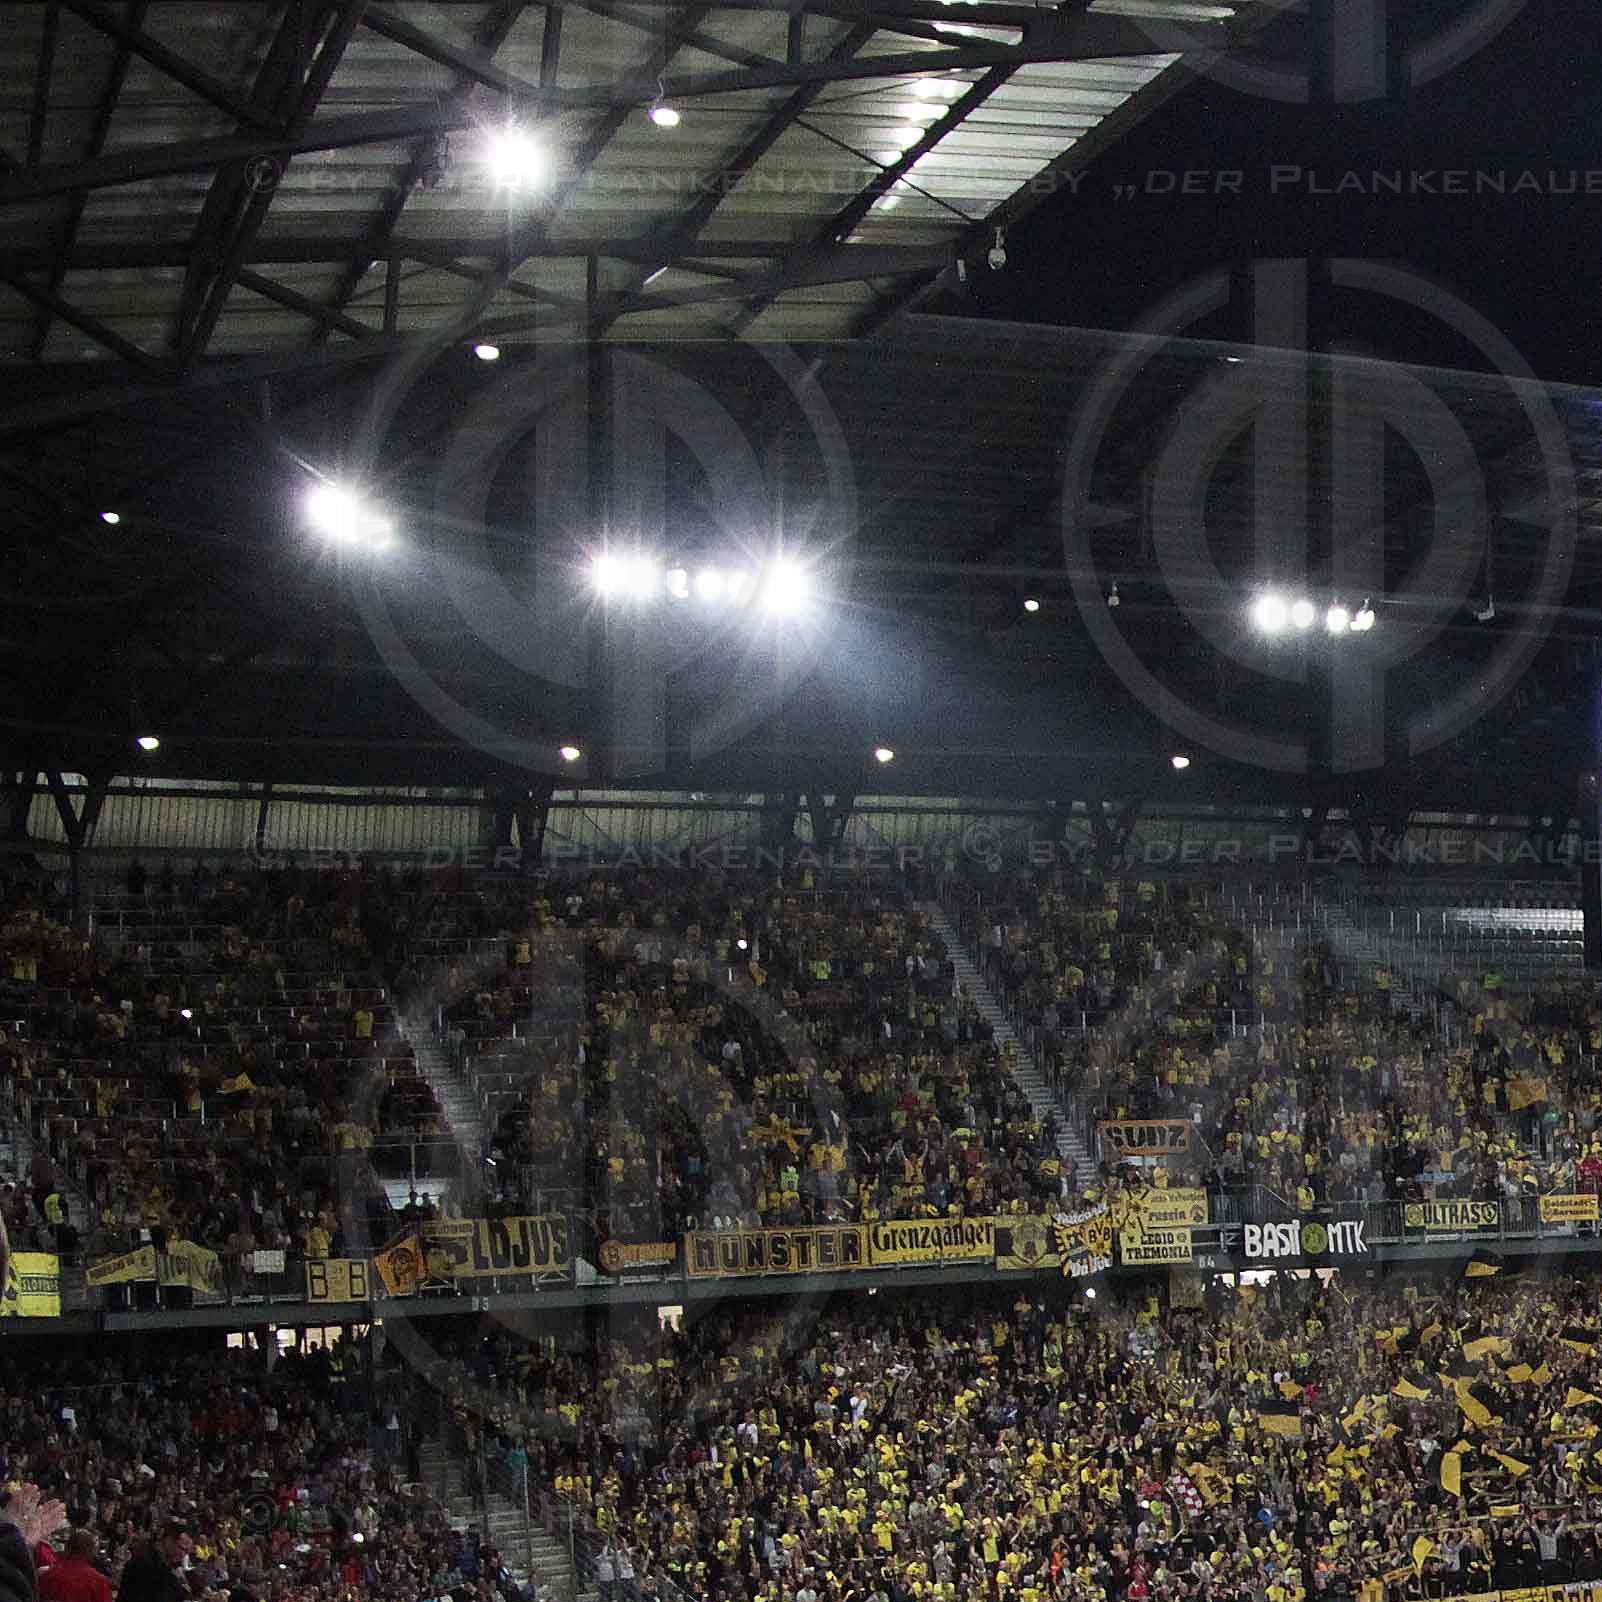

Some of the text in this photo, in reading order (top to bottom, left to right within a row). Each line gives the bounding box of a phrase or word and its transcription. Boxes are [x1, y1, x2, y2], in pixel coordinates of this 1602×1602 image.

[1423, 1202, 1481, 1224] ULTRAS
[1141, 1233, 1173, 1245] LEGIO
[1327, 1220, 1368, 1254] MTK
[1126, 1246, 1191, 1260] TREMONIA
